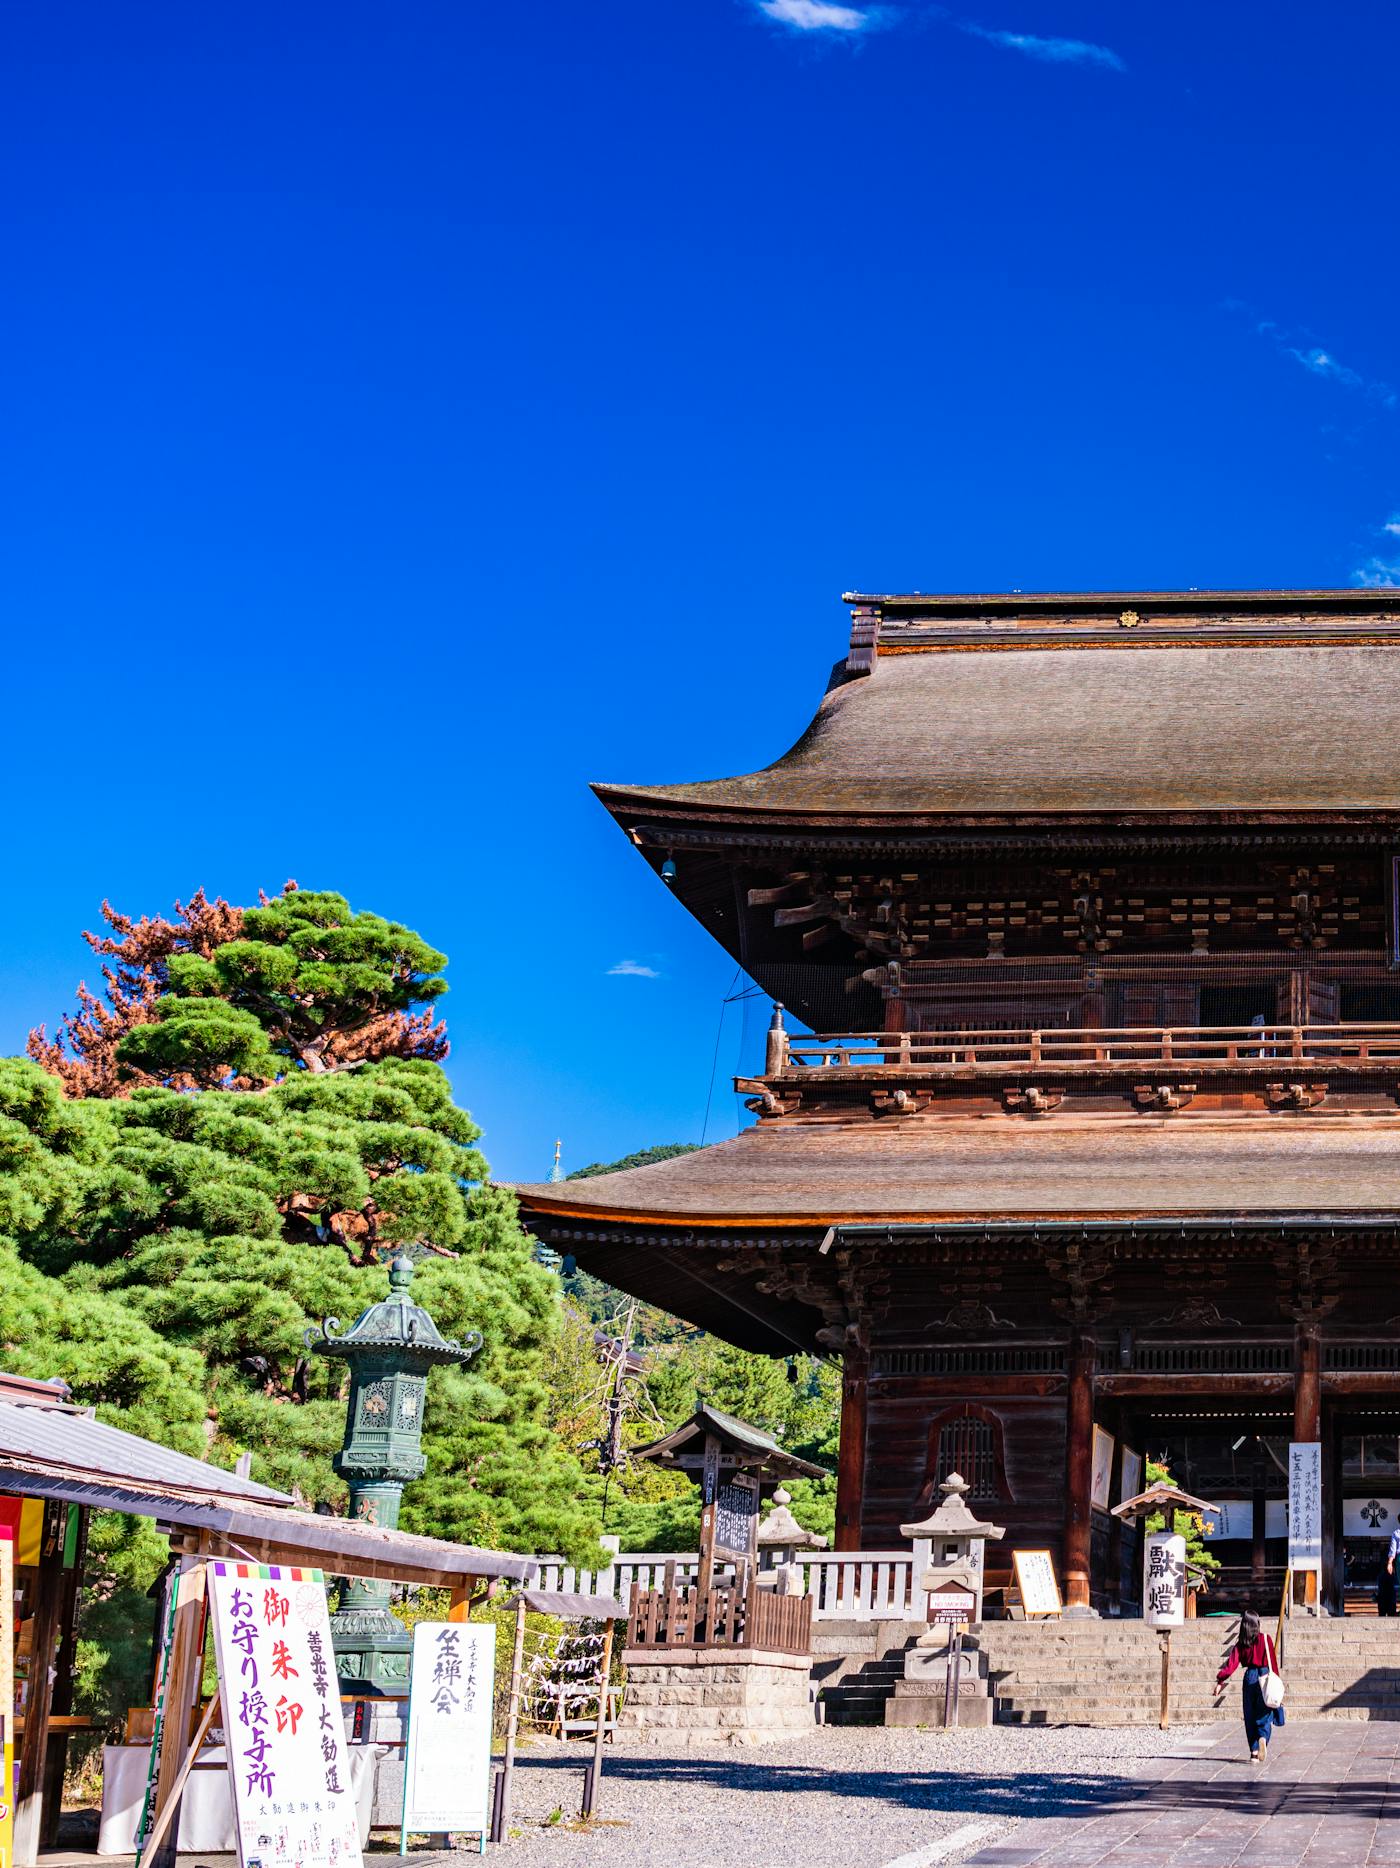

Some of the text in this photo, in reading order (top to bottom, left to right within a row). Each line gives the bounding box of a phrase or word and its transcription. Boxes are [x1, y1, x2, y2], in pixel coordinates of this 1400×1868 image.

[230, 1587, 276, 1798] お守り授与所
[263, 1587, 303, 1736] 御朱印
